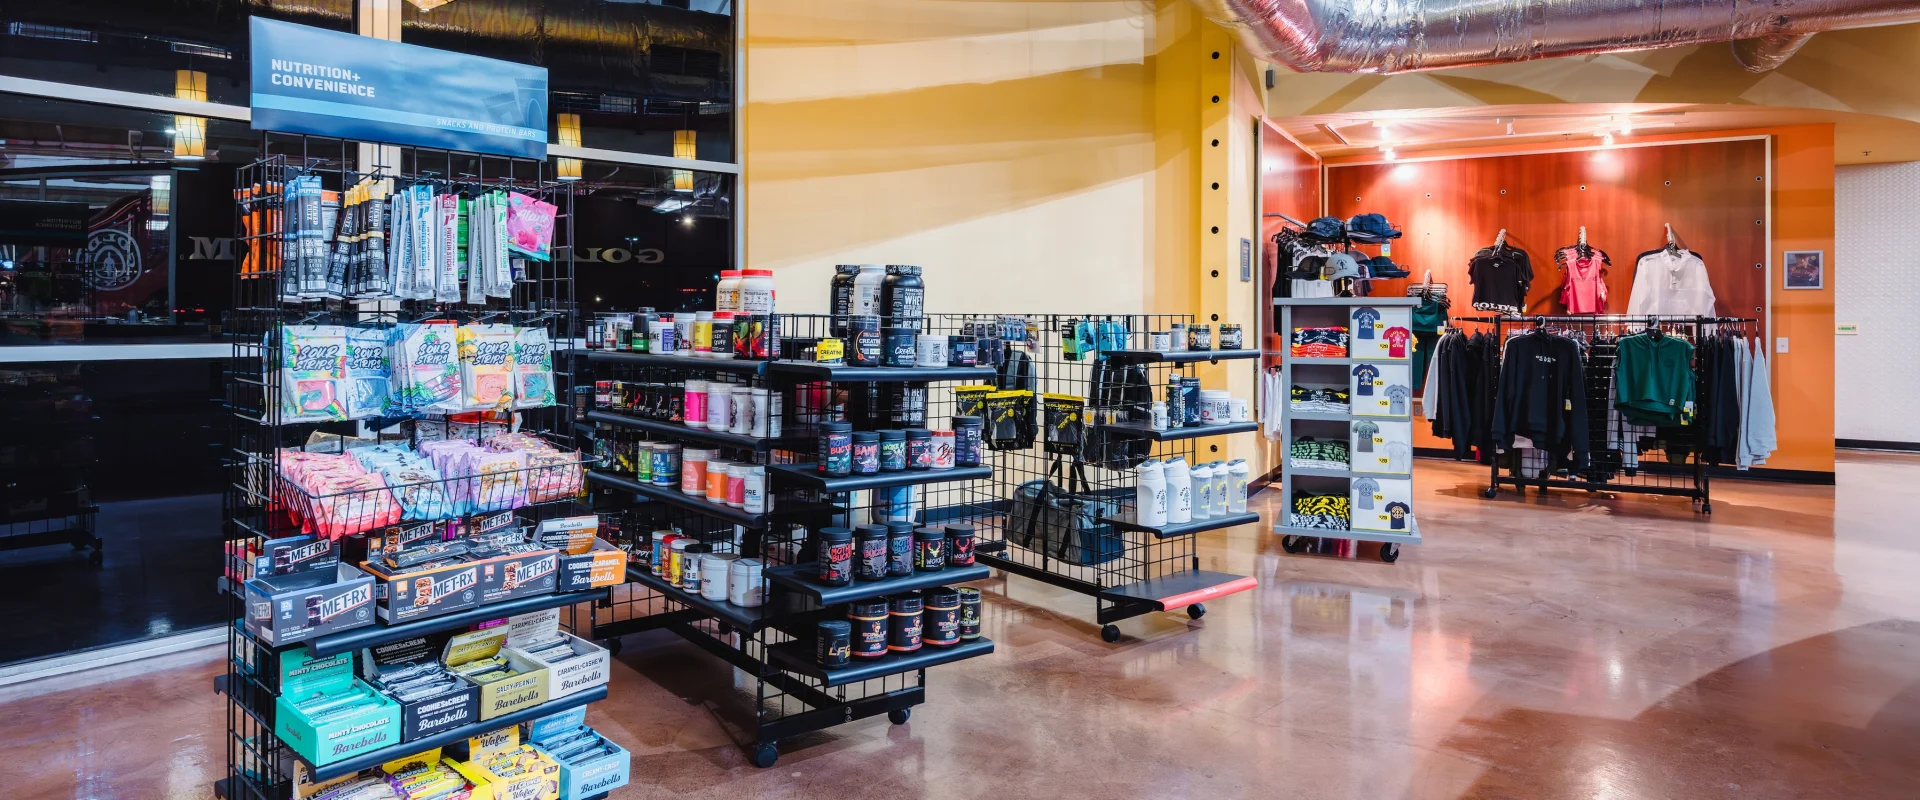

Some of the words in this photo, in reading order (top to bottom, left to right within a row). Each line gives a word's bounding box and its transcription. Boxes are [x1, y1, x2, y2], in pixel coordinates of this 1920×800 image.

[271, 58, 361, 82] NUTRITION+
[271, 73, 376, 98] CONVENIENCE
[436, 118, 467, 130] SNACKS
[468, 122, 485, 131] AND
[486, 123, 516, 136] PROTEIN
[518, 128, 537, 138] BARS
[904, 296, 922, 304] WHEY
[1472, 302, 1518, 312] GOLD'S
[300, 344, 340, 360] SOUR
[354, 346, 382, 360] SOUR
[418, 342, 450, 354] SOUR
[478, 341, 510, 355] SOUR
[520, 343, 546, 356] SOUR
[294, 358, 334, 372] STRIPS
[350, 359, 382, 370] STRIPS
[414, 354, 448, 366] STRIPS
[472, 354, 506, 366] STRIPS
[518, 354, 544, 365] STRIPS
[482, 512, 511, 530] MET-RX
[399, 524, 432, 544] MET-RX
[291, 540, 330, 562] MET-RX
[516, 559, 554, 582] MET-RX
[572, 572, 614, 585] Barebells
[433, 571, 474, 598] MET-RX
[322, 588, 368, 618] MET-RX
[289, 666, 311, 676] MINTY
[312, 658, 348, 672] CHOCOLATE
[561, 671, 602, 690] Barebells
[494, 690, 539, 710] Barebells
[328, 728, 352, 740] MINTY
[352, 716, 390, 732] CHOCOLATE
[418, 708, 468, 732] Barebells
[332, 732, 387, 756] Barebells
[480, 734, 510, 748] Wafer
[580, 774, 621, 794] Barebells
[512, 788, 536, 800] Wafer
